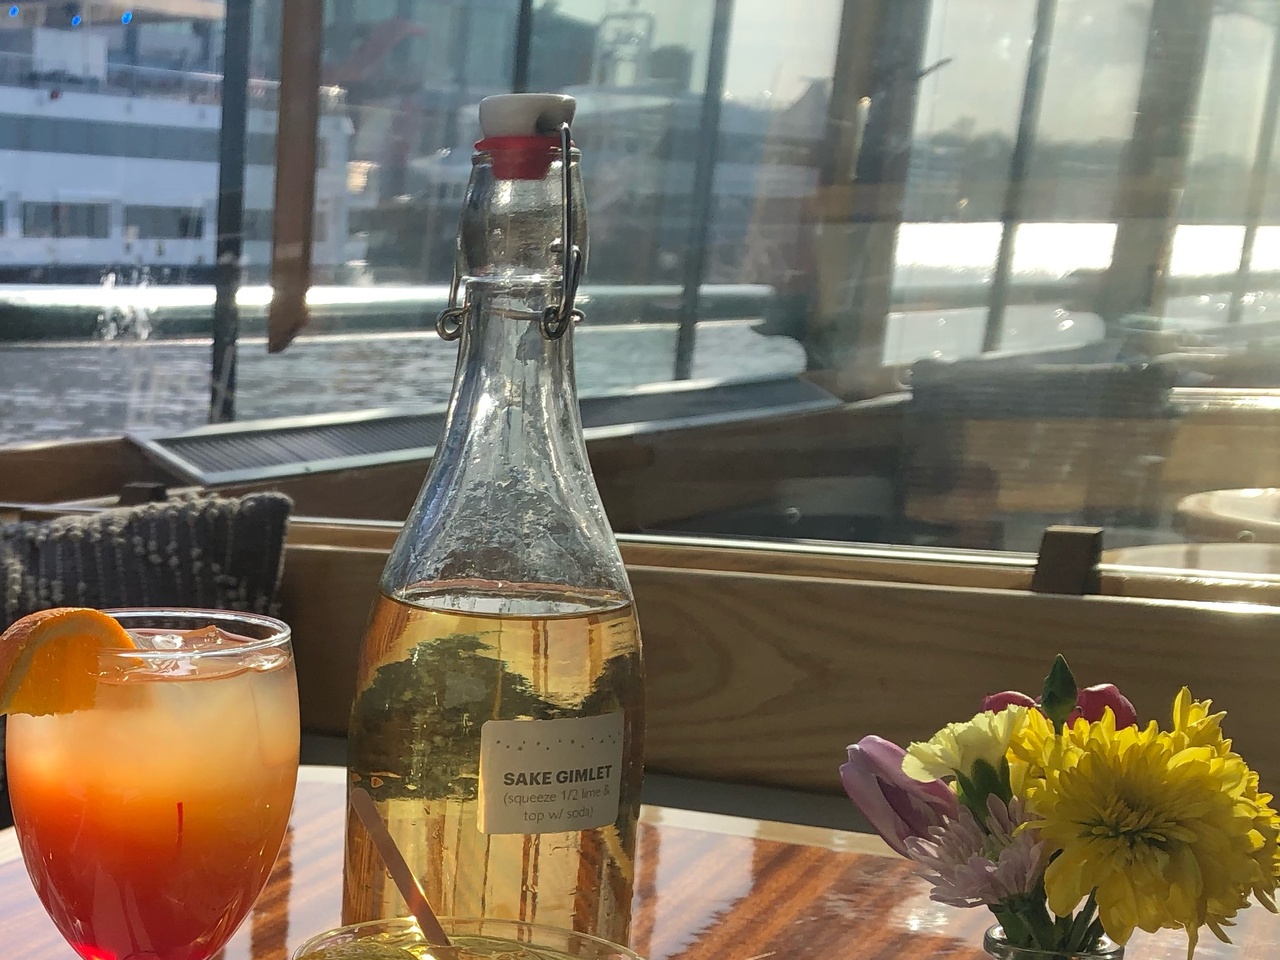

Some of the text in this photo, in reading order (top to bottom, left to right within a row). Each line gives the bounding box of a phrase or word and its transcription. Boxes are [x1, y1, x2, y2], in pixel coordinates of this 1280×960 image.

[503, 765, 613, 786] SAKE GIMLET
[503, 784, 610, 806] (squeeze 1/2 lime &
[524, 806, 594, 824] top w/ soda)
